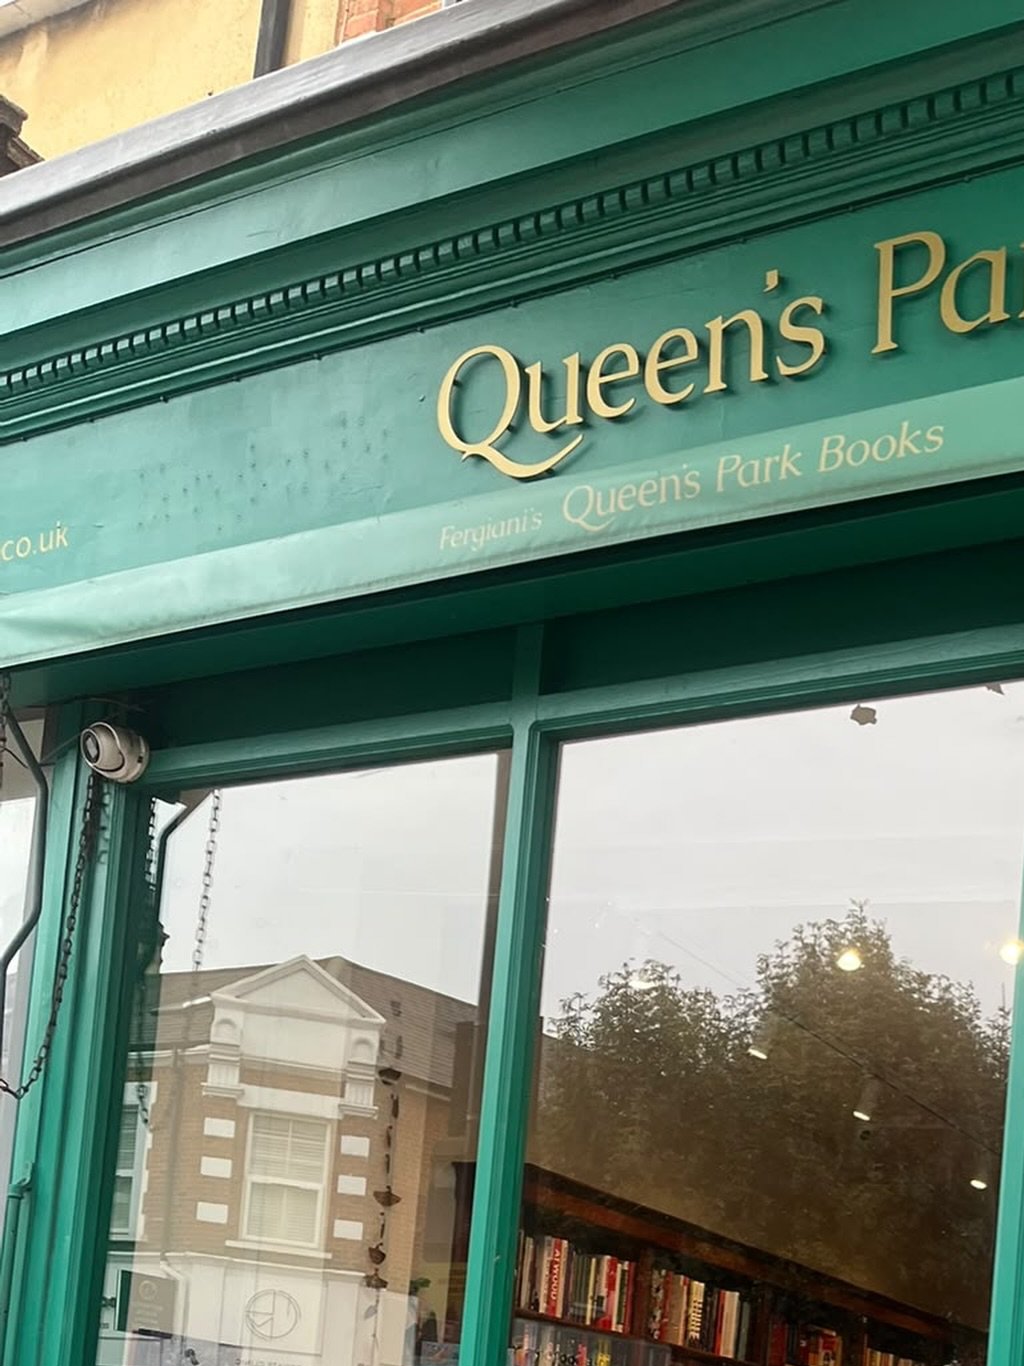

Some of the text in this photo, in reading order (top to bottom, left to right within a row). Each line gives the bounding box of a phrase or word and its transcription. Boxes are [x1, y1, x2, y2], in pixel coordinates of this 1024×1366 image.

[436, 268, 826, 480] Queen's
[438, 420, 945, 552] Fergiani's Queen's Park Books
